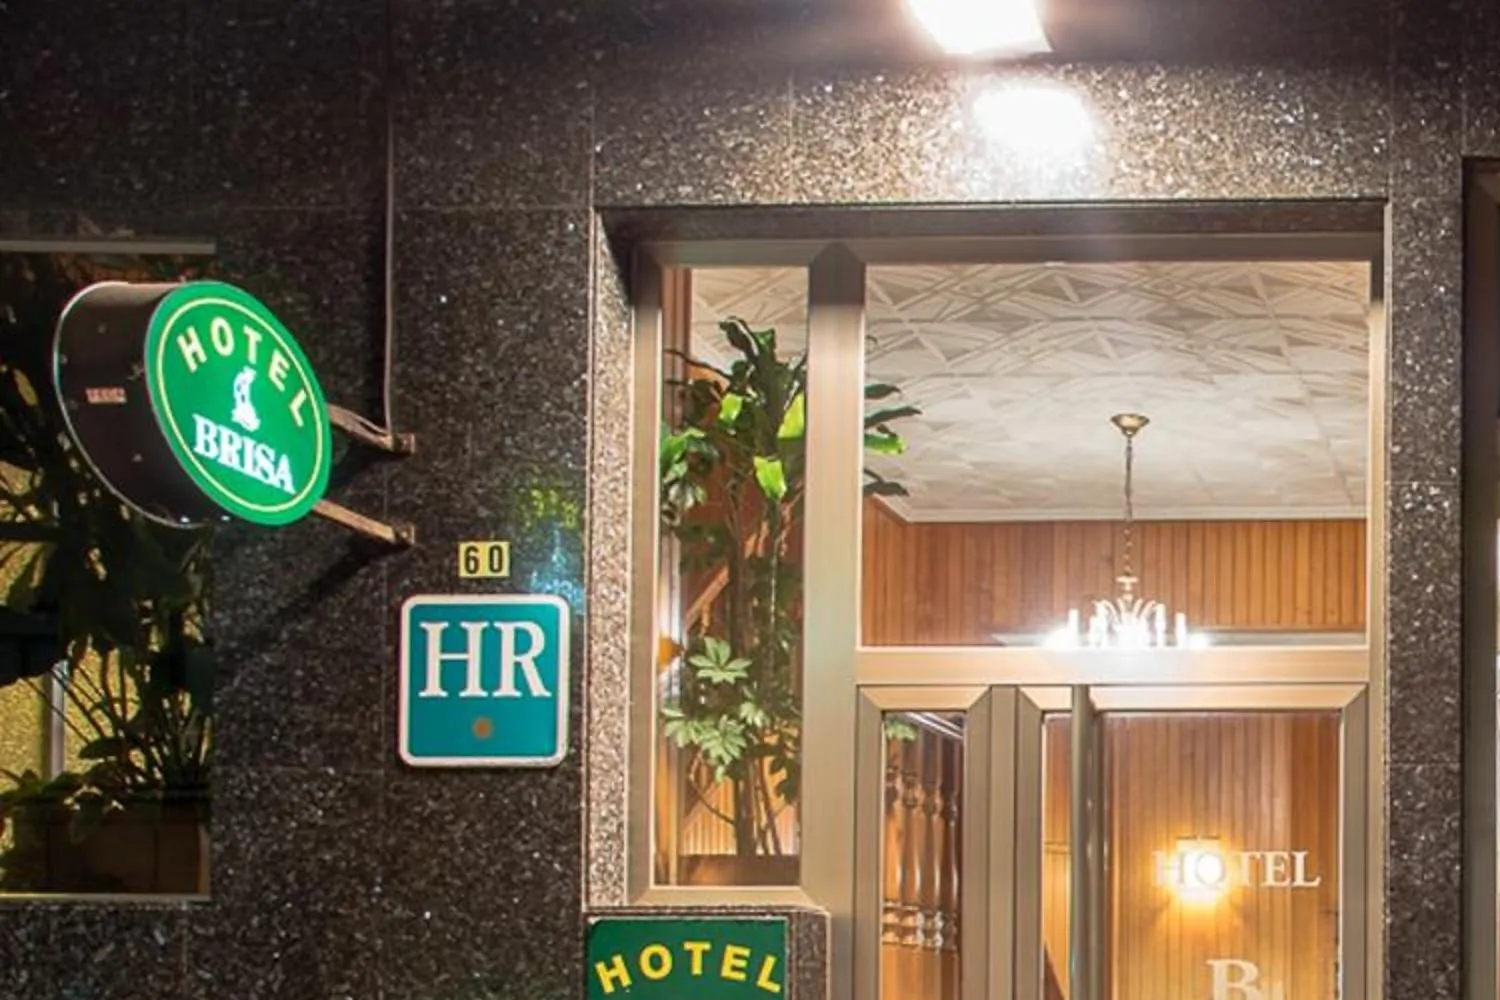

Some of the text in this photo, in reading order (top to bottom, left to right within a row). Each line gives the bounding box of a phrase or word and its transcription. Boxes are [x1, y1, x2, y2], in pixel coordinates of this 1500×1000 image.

[176, 316, 307, 428] HOTEL
[191, 413, 297, 495] BRISA
[464, 544, 505, 574] 60
[417, 620, 552, 698] HR
[1152, 850, 1322, 888] HOTEL
[594, 940, 782, 995] HOTEL
